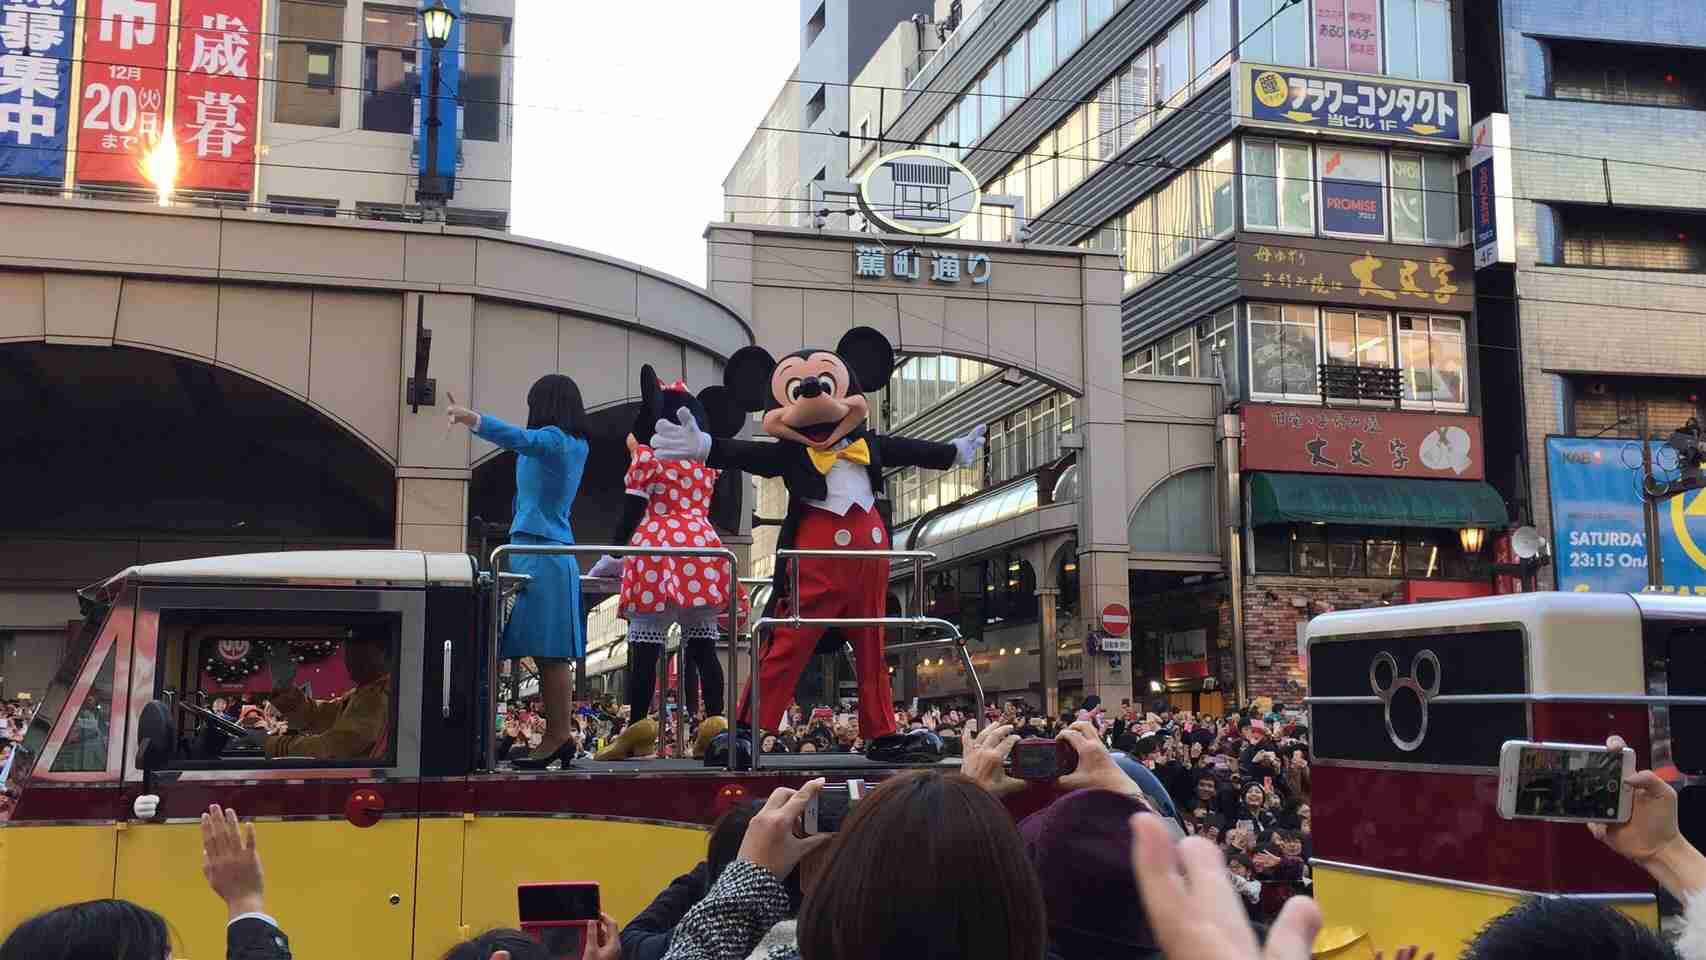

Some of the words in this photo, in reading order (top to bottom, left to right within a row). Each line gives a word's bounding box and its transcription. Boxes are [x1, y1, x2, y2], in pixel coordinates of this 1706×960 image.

[109, 65, 142, 81] 12月
[184, 13, 250, 158] 歳暮
[83, 83, 137, 132] 20
[1288, 77, 1454, 126] フラワーコンタクト
[1328, 114, 1374, 129] 当ビル
[1379, 119, 1398, 131] 1F
[101, 134, 138, 149] まで
[1327, 197, 1377, 213] PROMISE
[1569, 553, 1615, 568] 23:15
